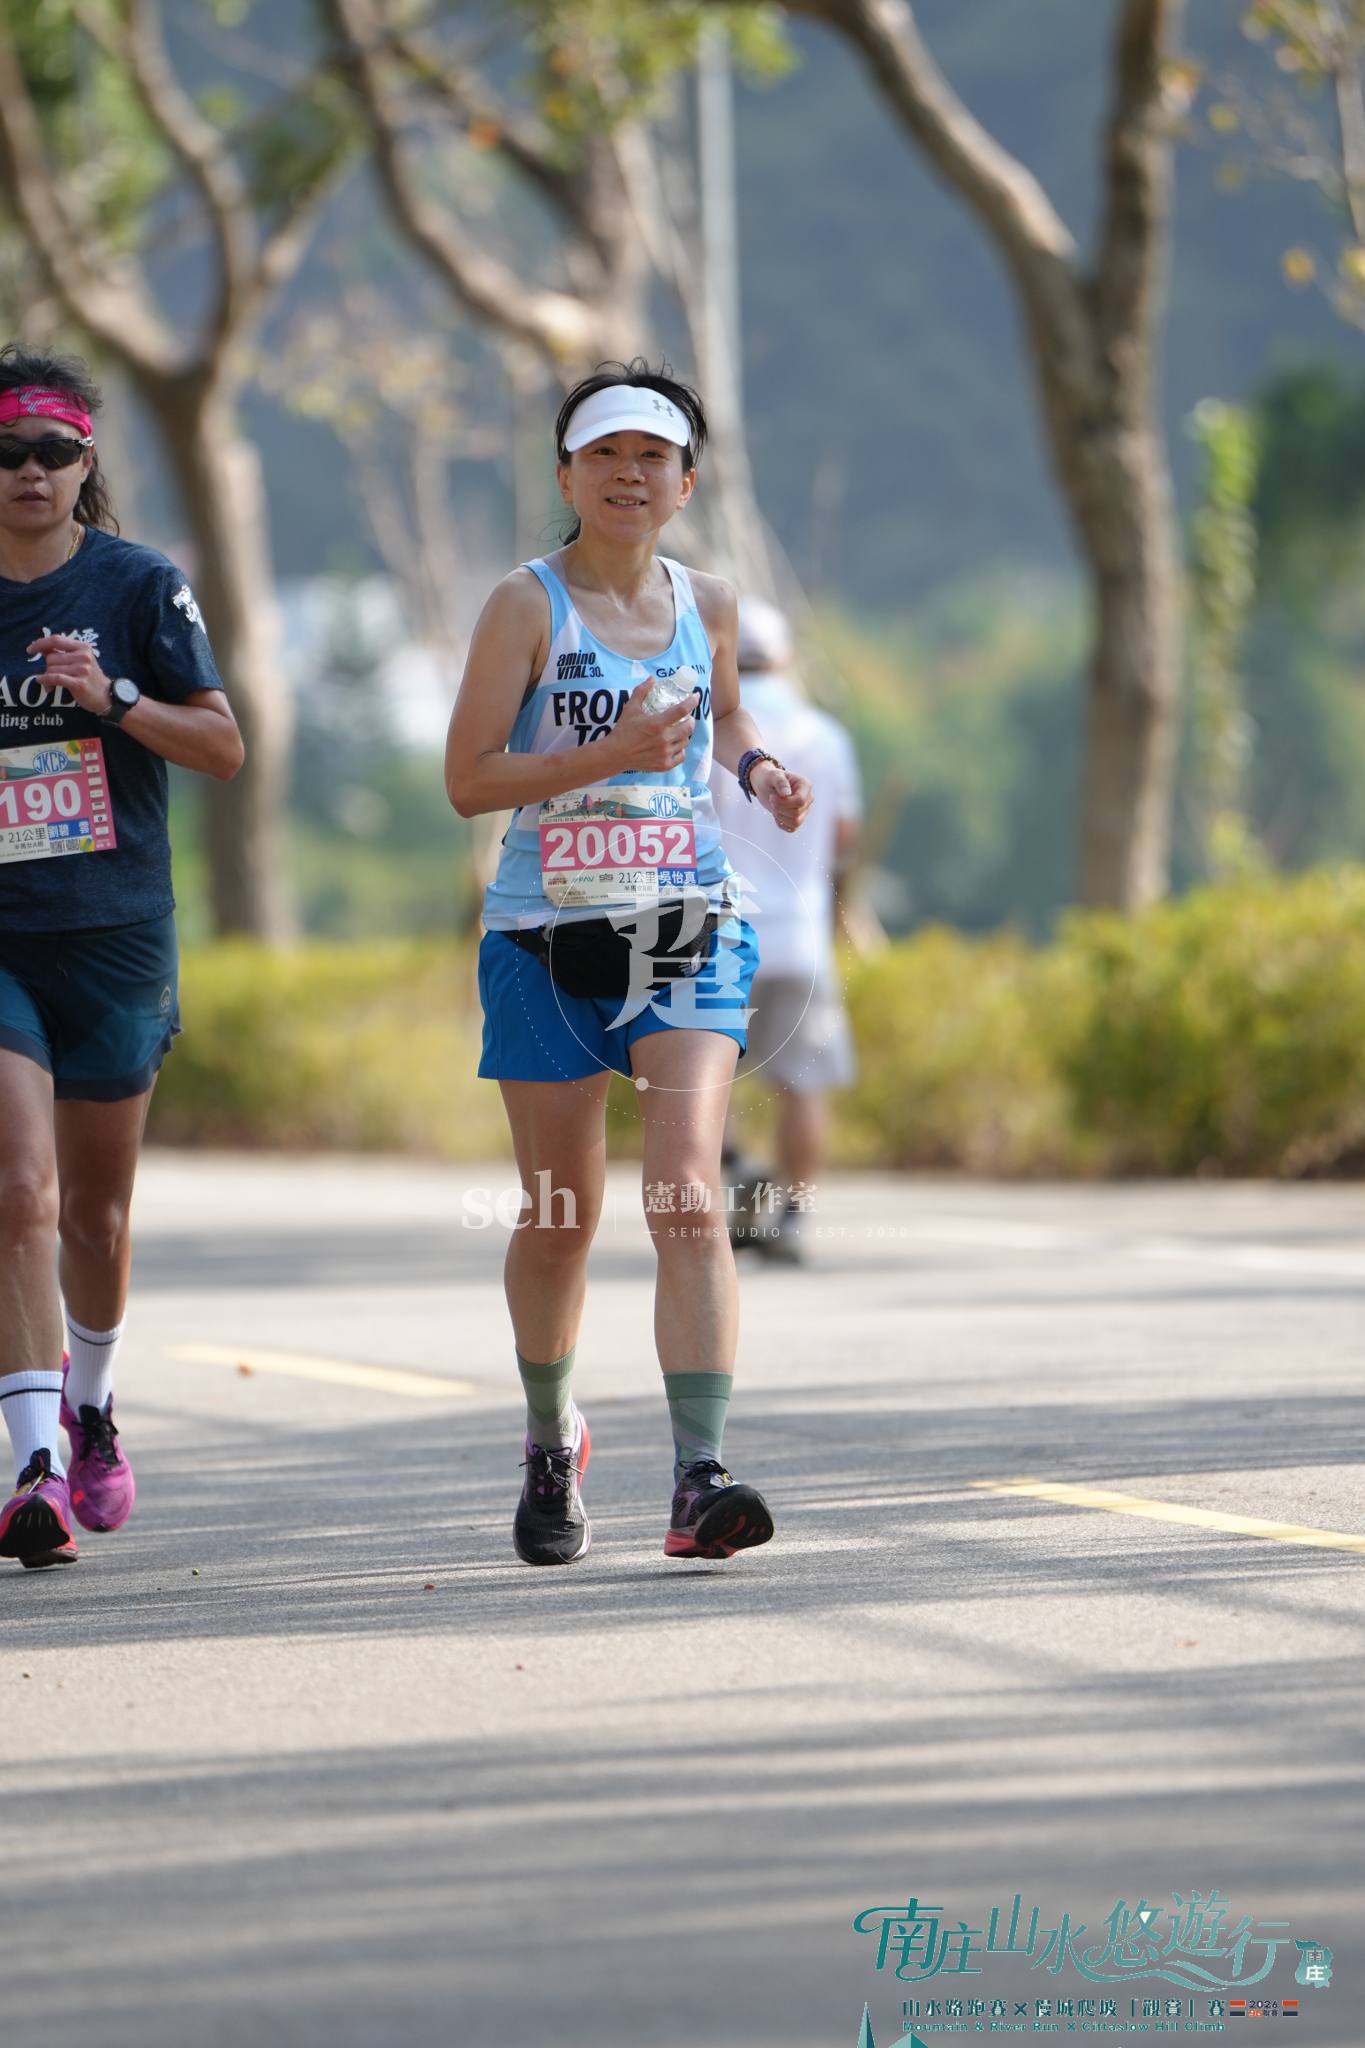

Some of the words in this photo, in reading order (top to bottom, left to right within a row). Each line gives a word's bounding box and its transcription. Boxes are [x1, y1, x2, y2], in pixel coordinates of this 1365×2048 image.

[557, 650, 596, 666] amino
[557, 665, 588, 680] VITAL
[656, 664, 706, 678] GAIN
[33, 713, 64, 726] club
[0, 779, 81, 824] 190
[649, 794, 680, 817] JKCR
[8, 827, 46, 843] 21公里
[545, 825, 693, 868] 20052
[619, 871, 657, 884] 21公里
